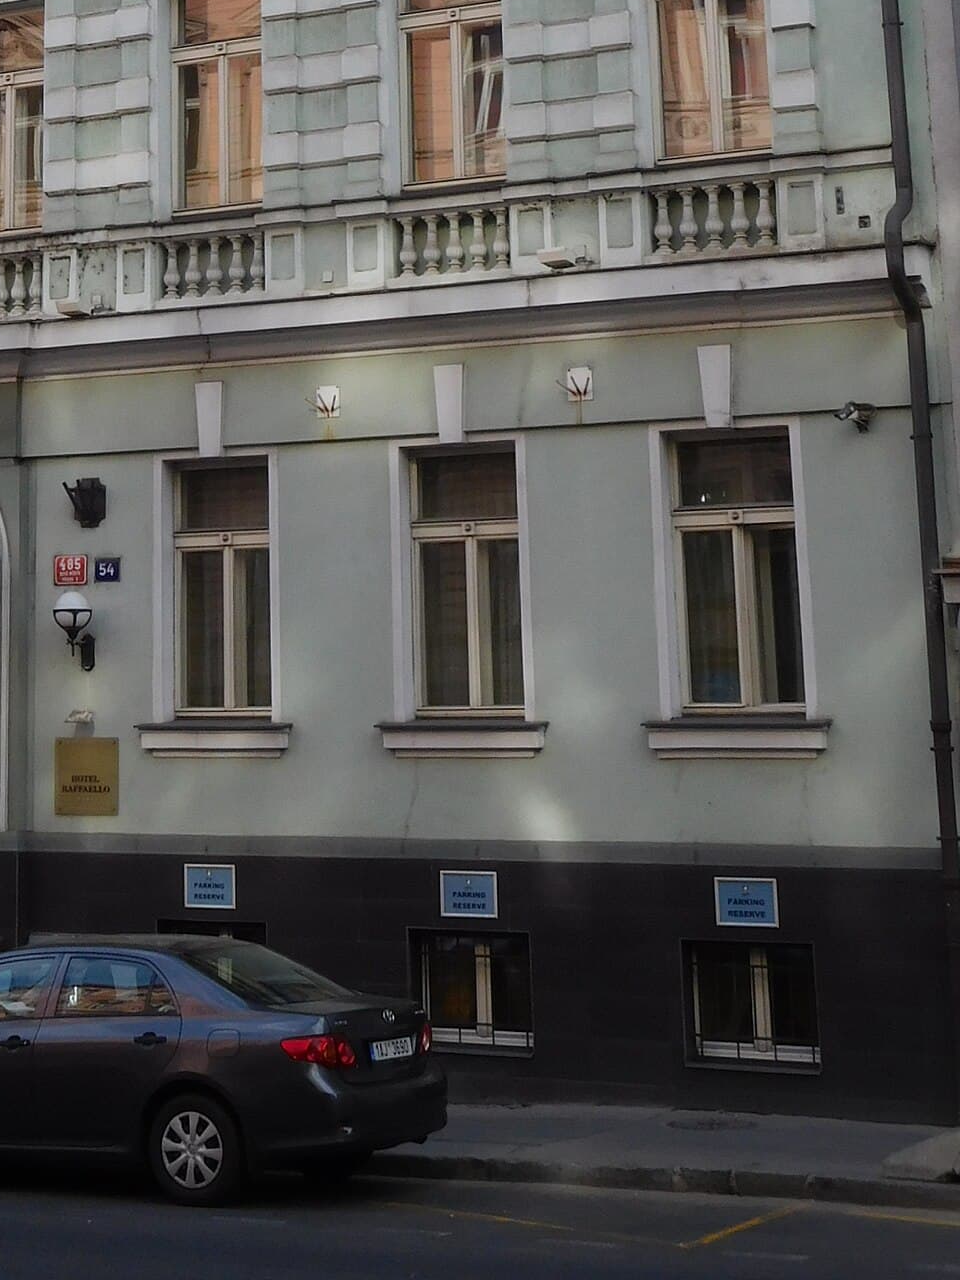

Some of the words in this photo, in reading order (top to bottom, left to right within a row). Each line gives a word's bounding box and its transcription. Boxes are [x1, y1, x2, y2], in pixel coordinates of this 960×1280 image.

[99, 563, 115, 576] 54
[71, 775, 100, 783] HOTEL
[62, 785, 111, 793] RAFFAELLO
[452, 891, 487, 899] PARKING
[727, 898, 766, 906] PARKING
[727, 910, 766, 919] RESERVE
